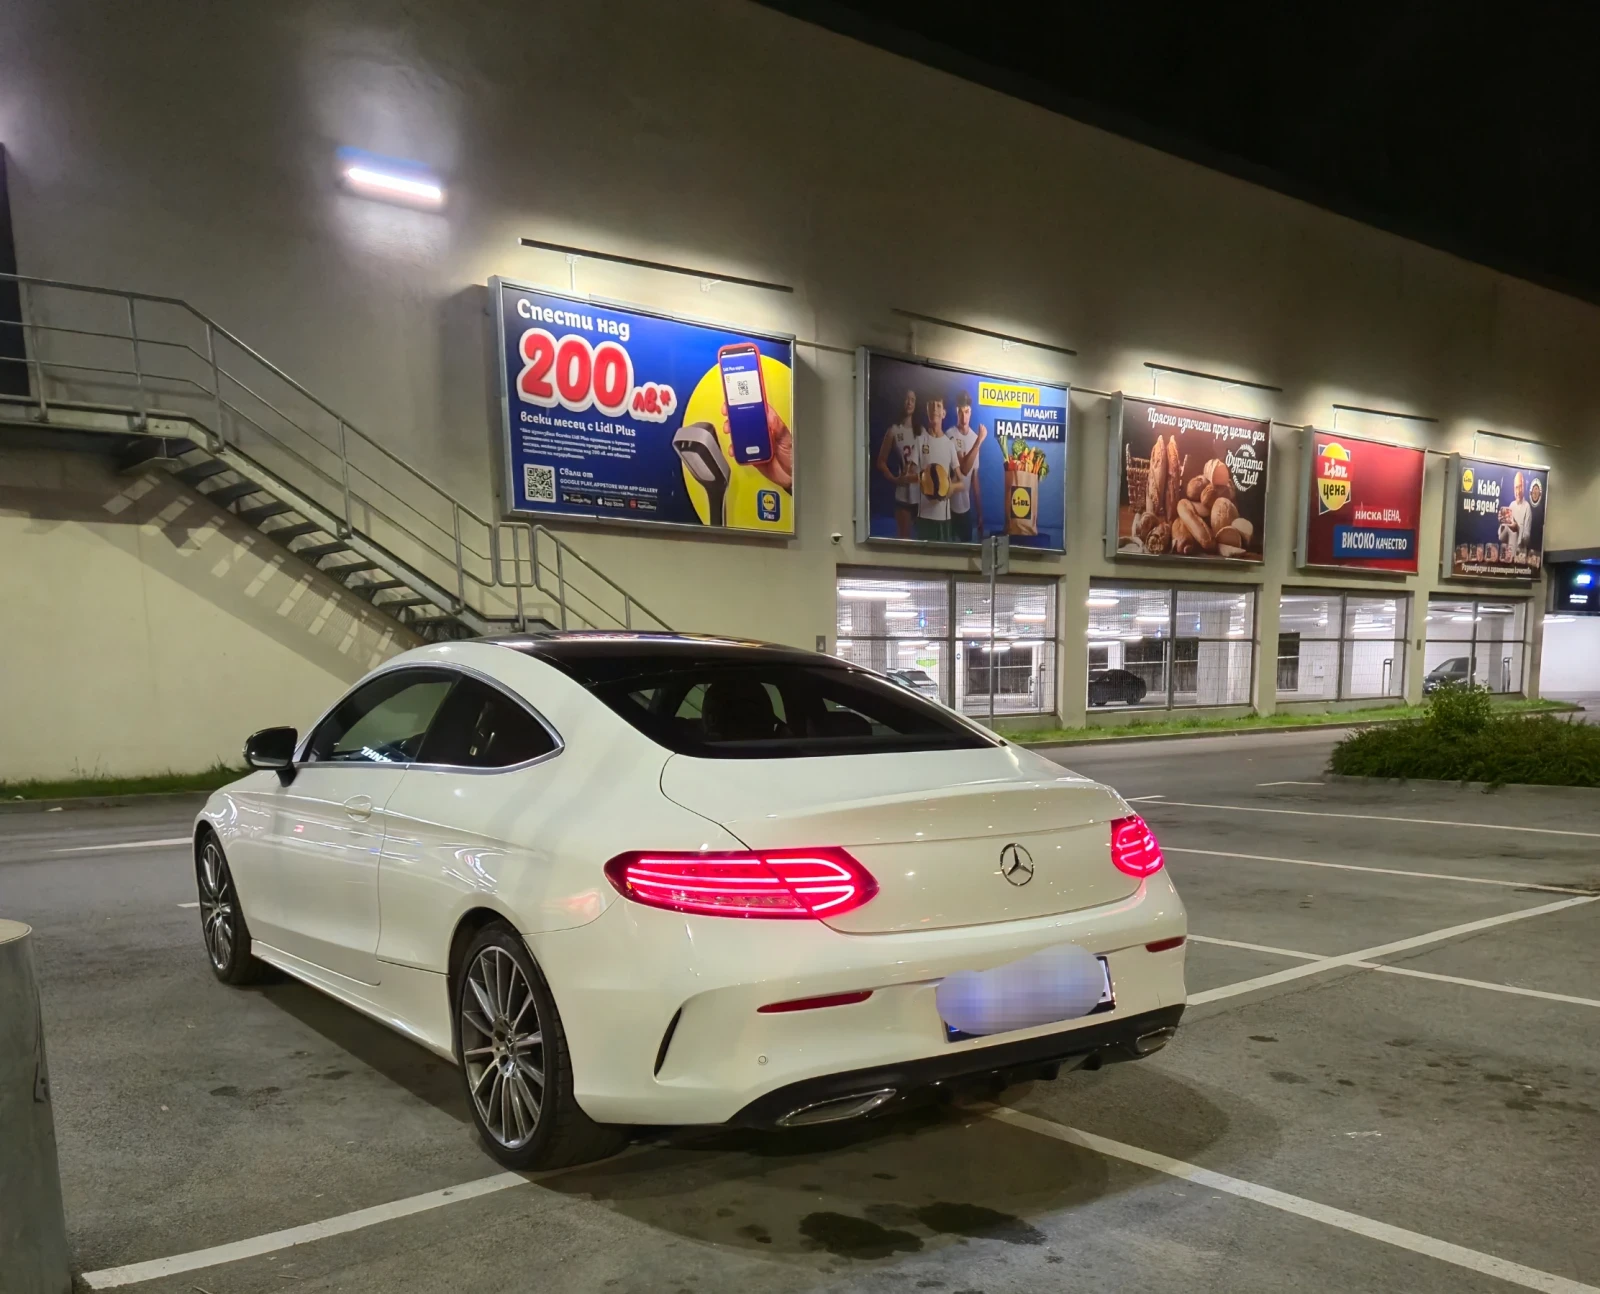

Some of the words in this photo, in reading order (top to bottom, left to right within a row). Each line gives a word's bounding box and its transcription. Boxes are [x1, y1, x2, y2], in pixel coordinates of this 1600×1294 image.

[517, 299, 593, 331] Спести
[597, 318, 630, 341] над
[519, 331, 631, 413] 200
[982, 388, 1035, 404] ПОДКРЕПИ
[1023, 408, 1057, 420] МЛАДИТЕ
[520, 411, 551, 425] всеки
[554, 418, 586, 432] месец
[587, 423, 593, 431] с
[595, 422, 613, 434] Lidl
[616, 425, 636, 437] Plus
[996, 421, 1059, 441] НАДЕЖДИ!
[1148, 408, 1176, 428] Прясно
[1177, 417, 1211, 434] изпечени
[1212, 423, 1229, 441] през
[1230, 426, 1251, 440] целия
[1252, 431, 1265, 446] ден
[1225, 450, 1263, 473] Фурната
[559, 468, 581, 477] Свали
[1323, 484, 1346, 500] цена
[1477, 479, 1500, 497] Какво
[763, 511, 775, 520] Plus
[1463, 499, 1475, 513] ще
[1476, 498, 1500, 516] ядем?
[1341, 532, 1375, 549] ВИСОКО
[1375, 538, 1407, 550] КАЧЕСТВО
